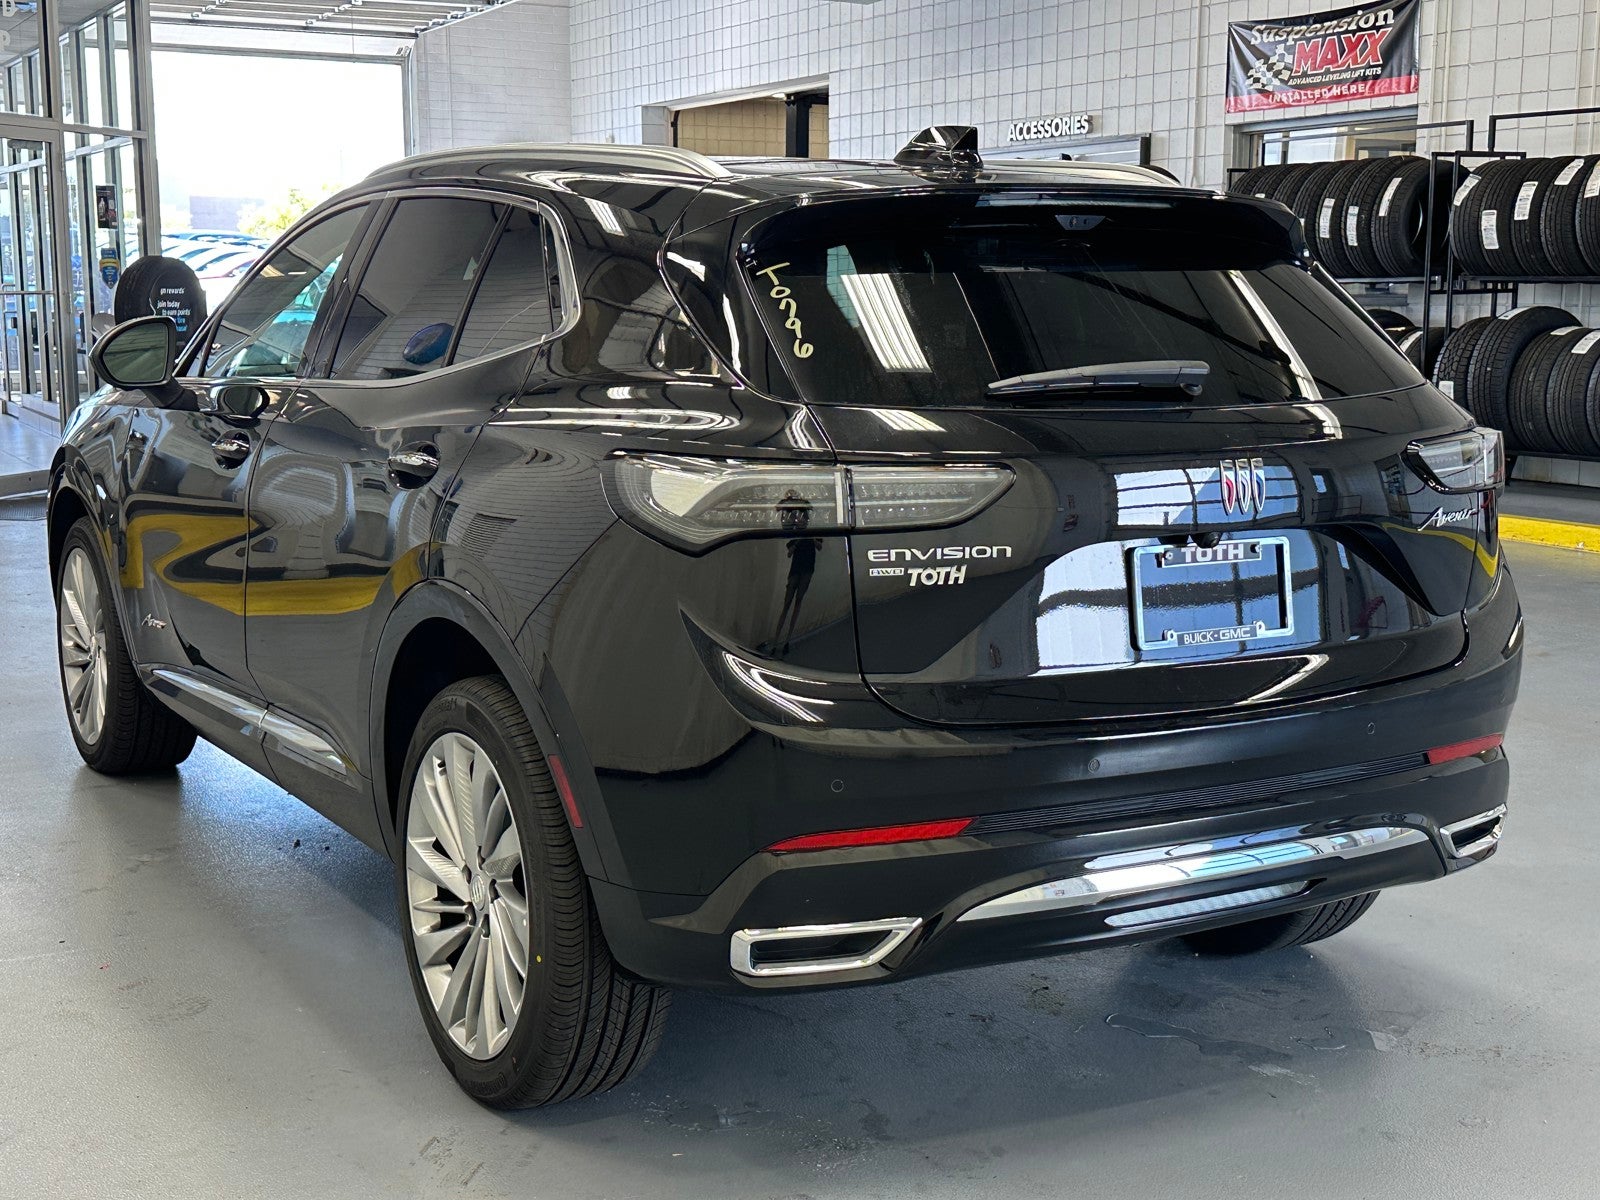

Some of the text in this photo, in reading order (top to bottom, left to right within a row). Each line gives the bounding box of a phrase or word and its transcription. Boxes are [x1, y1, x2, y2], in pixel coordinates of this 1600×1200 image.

[1250, 8, 1395, 45] Suspension
[1291, 28, 1393, 76] MAXX
[1288, 67, 1381, 86] ADVANCED LEVELING LIFT KITS
[1269, 84, 1365, 104] INSTALLED HERE
[1006, 114, 1089, 142] ACCESSORIES
[166, 300, 180, 309] today
[867, 545, 1012, 562] ENVISION
[1181, 543, 1244, 563] TOTH
[869, 567, 905, 577] AWD
[907, 564, 968, 587] TOTH
